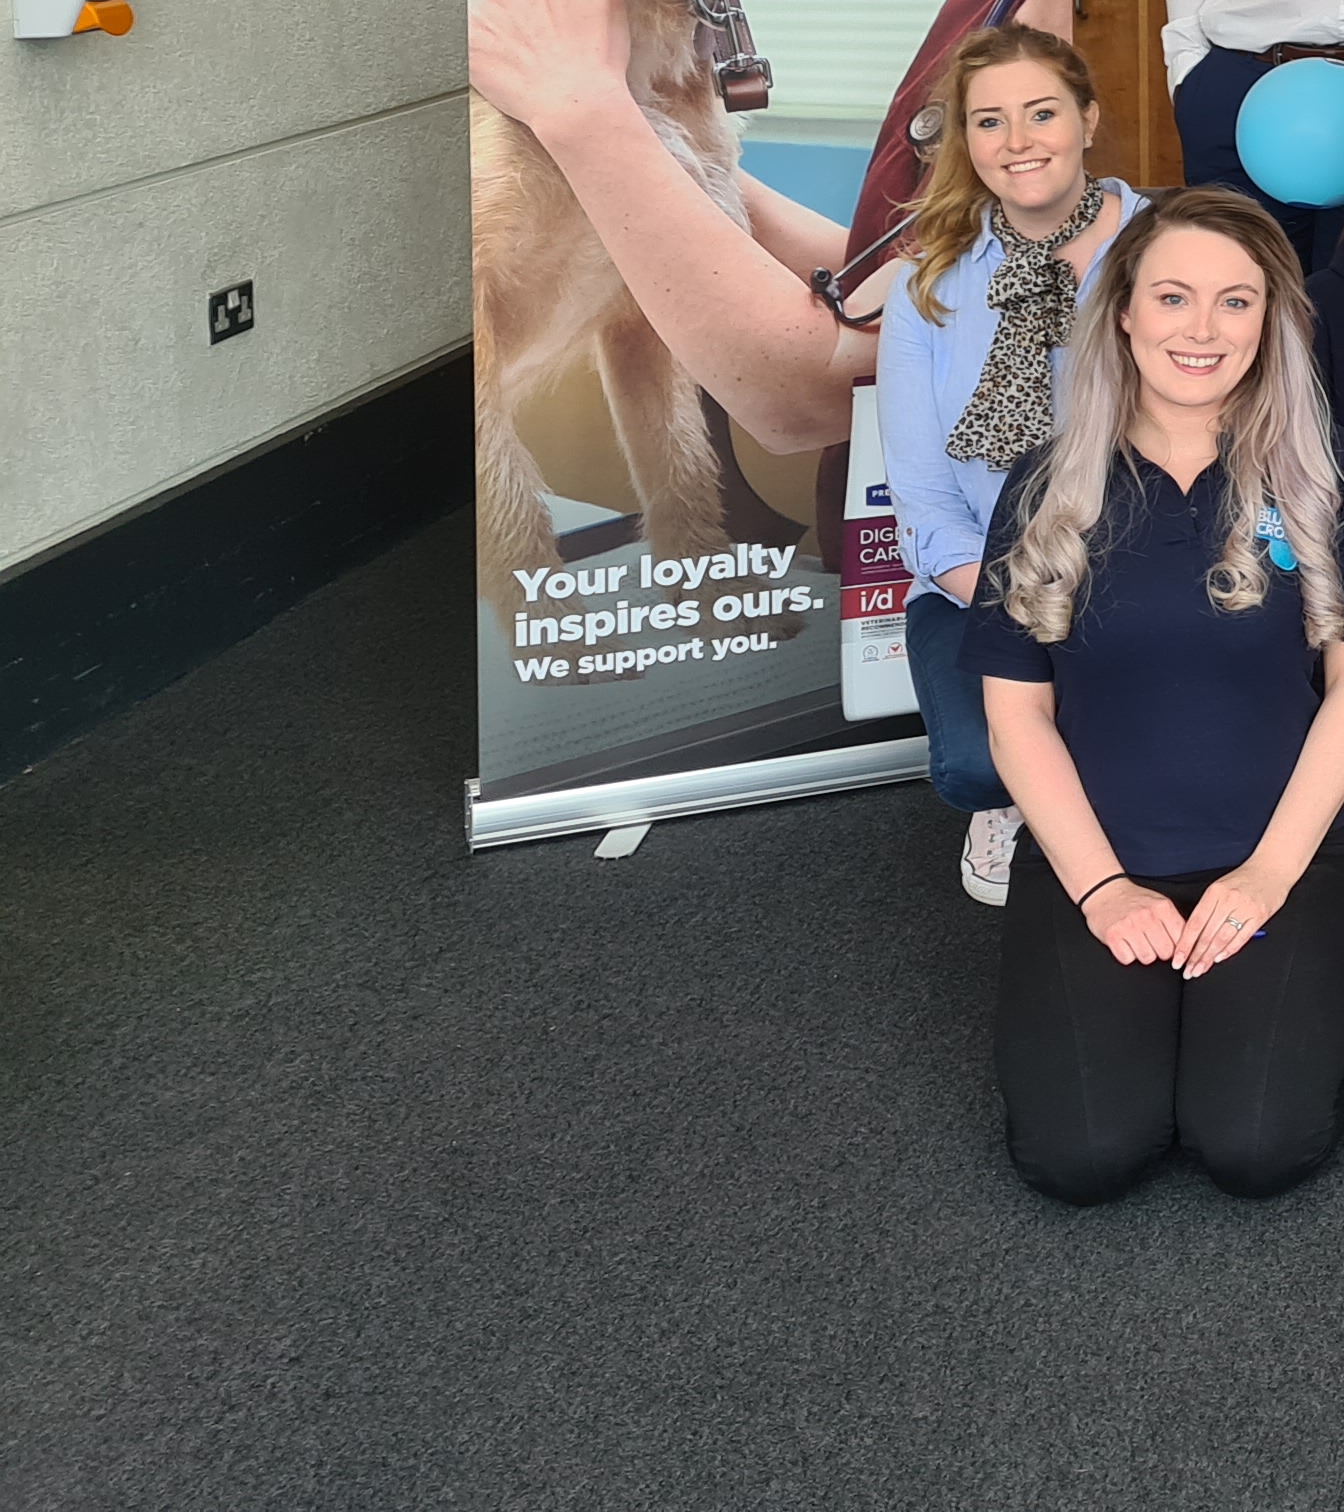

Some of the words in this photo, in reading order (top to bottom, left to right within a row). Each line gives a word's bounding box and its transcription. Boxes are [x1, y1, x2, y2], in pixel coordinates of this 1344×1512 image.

[872, 489, 890, 499] PRE
[1257, 508, 1283, 526] BLU
[1255, 522, 1286, 540] CRO
[860, 545, 900, 564] CAR
[512, 564, 628, 603] Your
[640, 542, 797, 591] loyalty
[860, 588, 894, 612] i/d
[514, 600, 701, 647] inspires
[712, 585, 824, 622] ours.
[513, 655, 570, 682] We
[577, 638, 705, 675] support
[711, 632, 778, 662] you.
